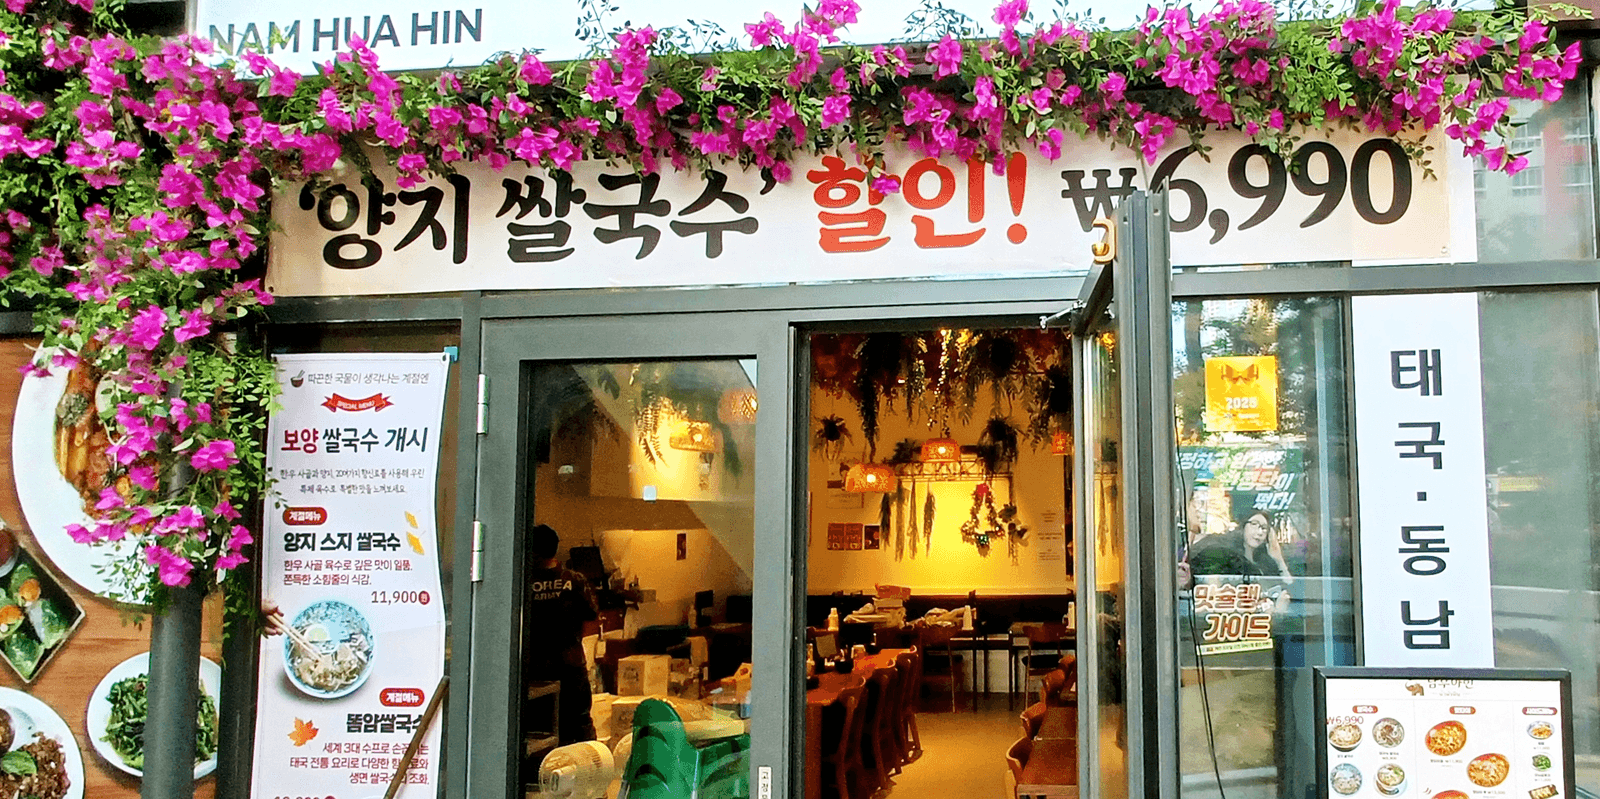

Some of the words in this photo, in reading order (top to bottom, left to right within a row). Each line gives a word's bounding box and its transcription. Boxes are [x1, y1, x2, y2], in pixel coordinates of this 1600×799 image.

[208, 20, 300, 56] NAM
[312, 15, 400, 51] HUA
[411, 8, 482, 46] HIN
[806, 151, 1028, 254] 할인!
[308, 373, 332, 385] 따끈한
[335, 373, 361, 384] 국물이
[364, 373, 400, 384] 생각나는
[402, 373, 429, 385] 계절엔
[281, 428, 319, 454] 보양
[323, 428, 379, 454] 쌀국수
[385, 427, 428, 452] 개시
[280, 469, 296, 480] 한우
[410, 468, 425, 479] 우린
[1252, 492, 1296, 510] 떴다!
[289, 511, 322, 521] 계절메뉴
[284, 532, 316, 552] 양지
[320, 532, 352, 551] 스지
[357, 532, 400, 551] 쌀국수
[284, 560, 303, 572] 한우
[304, 560, 323, 571] 사골
[325, 560, 352, 571] 육수로
[354, 560, 373, 571] 깊은
[374, 560, 392, 571] 맛이
[284, 574, 311, 585] 쫀득한
[312, 574, 350, 585] 소힘줄의
[351, 574, 372, 585] 식감.
[532, 579, 572, 592] OREA
[1194, 584, 1260, 612] 맛슐랭
[1203, 613, 1271, 641] 가이드
[386, 692, 420, 703] 계절메뉴
[323, 743, 342, 754] 세계
[344, 743, 360, 754] 3대
[363, 743, 390, 754] 수프로
[290, 757, 308, 768] 태국
[310, 757, 329, 768] 전통
[331, 757, 359, 768] 요리로
[362, 757, 389, 769] 다양한
[349, 773, 368, 784] 생면
[409, 773, 430, 785] 조화.
